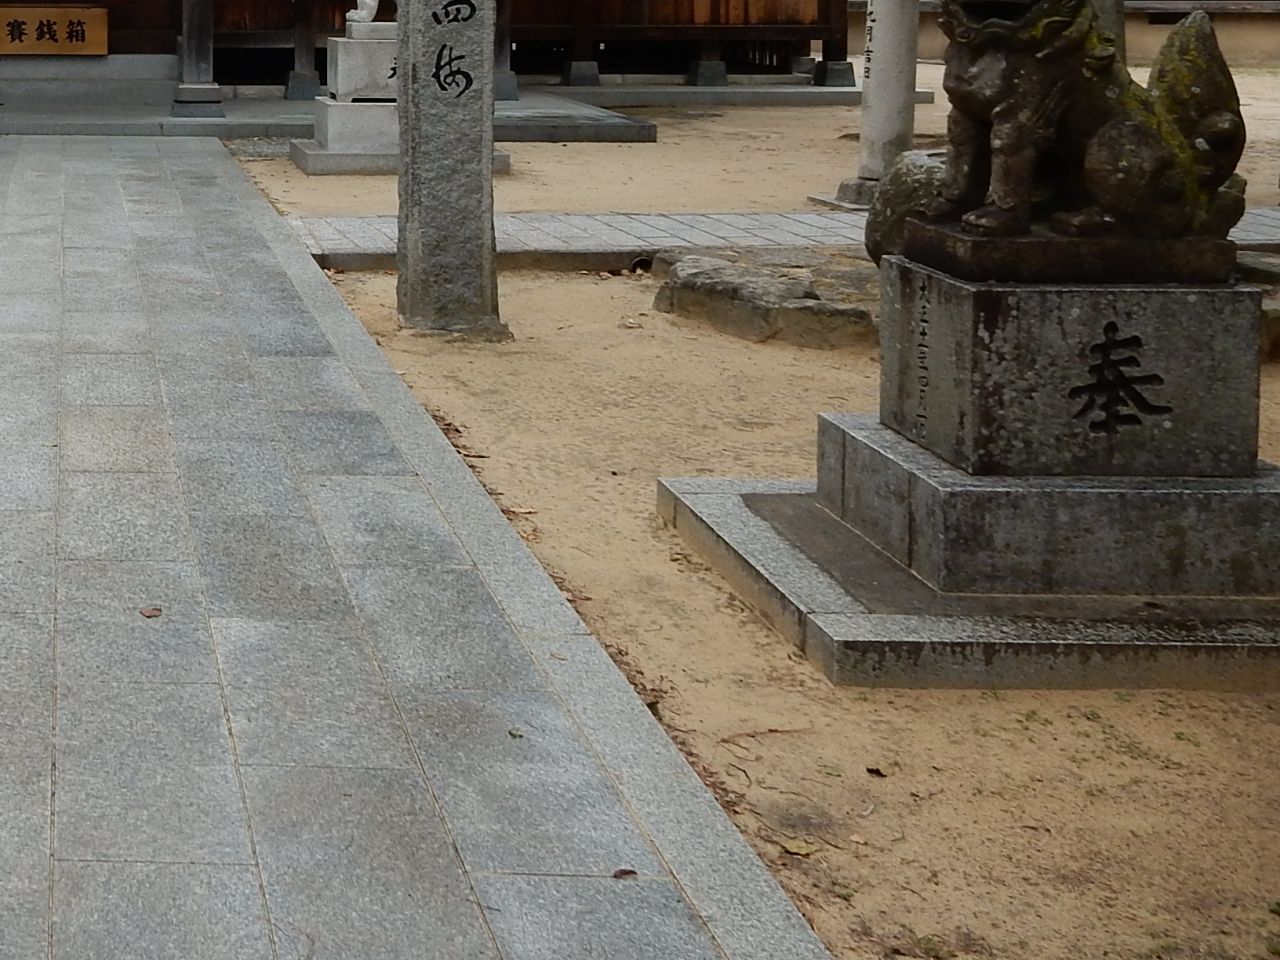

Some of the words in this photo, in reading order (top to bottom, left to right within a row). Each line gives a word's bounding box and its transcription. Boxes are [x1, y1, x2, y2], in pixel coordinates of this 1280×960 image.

[6, 19, 87, 44] 賽銭箱
[1067, 320, 1174, 436] 奉
